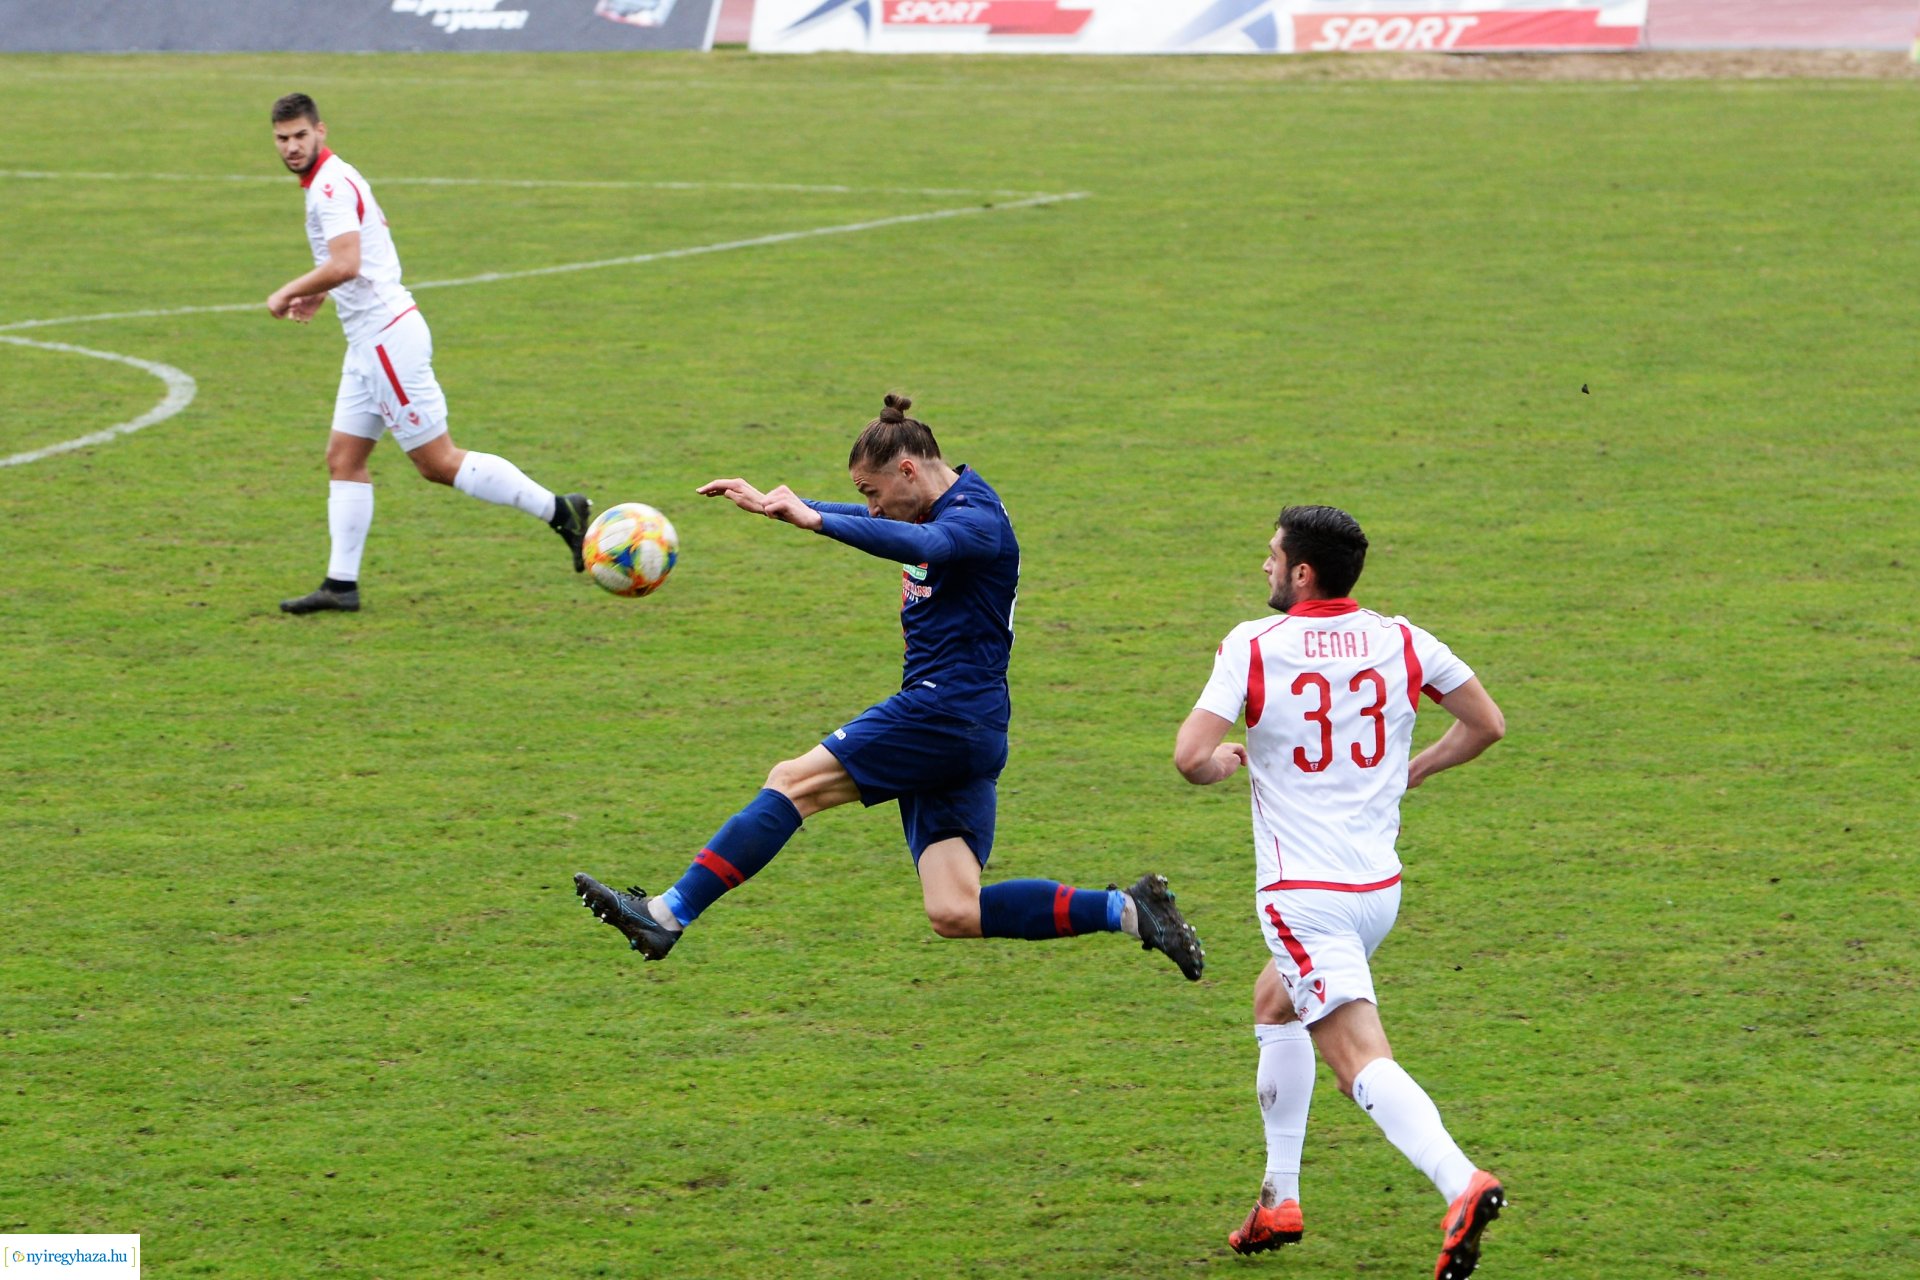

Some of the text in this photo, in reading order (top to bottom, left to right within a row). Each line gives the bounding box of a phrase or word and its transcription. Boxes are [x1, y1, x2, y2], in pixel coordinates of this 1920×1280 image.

[890, 1, 990, 22] SPORT
[1311, 16, 1480, 51] SPORT
[1304, 630, 1369, 658] CENAJ
[1291, 667, 1387, 773] 33
